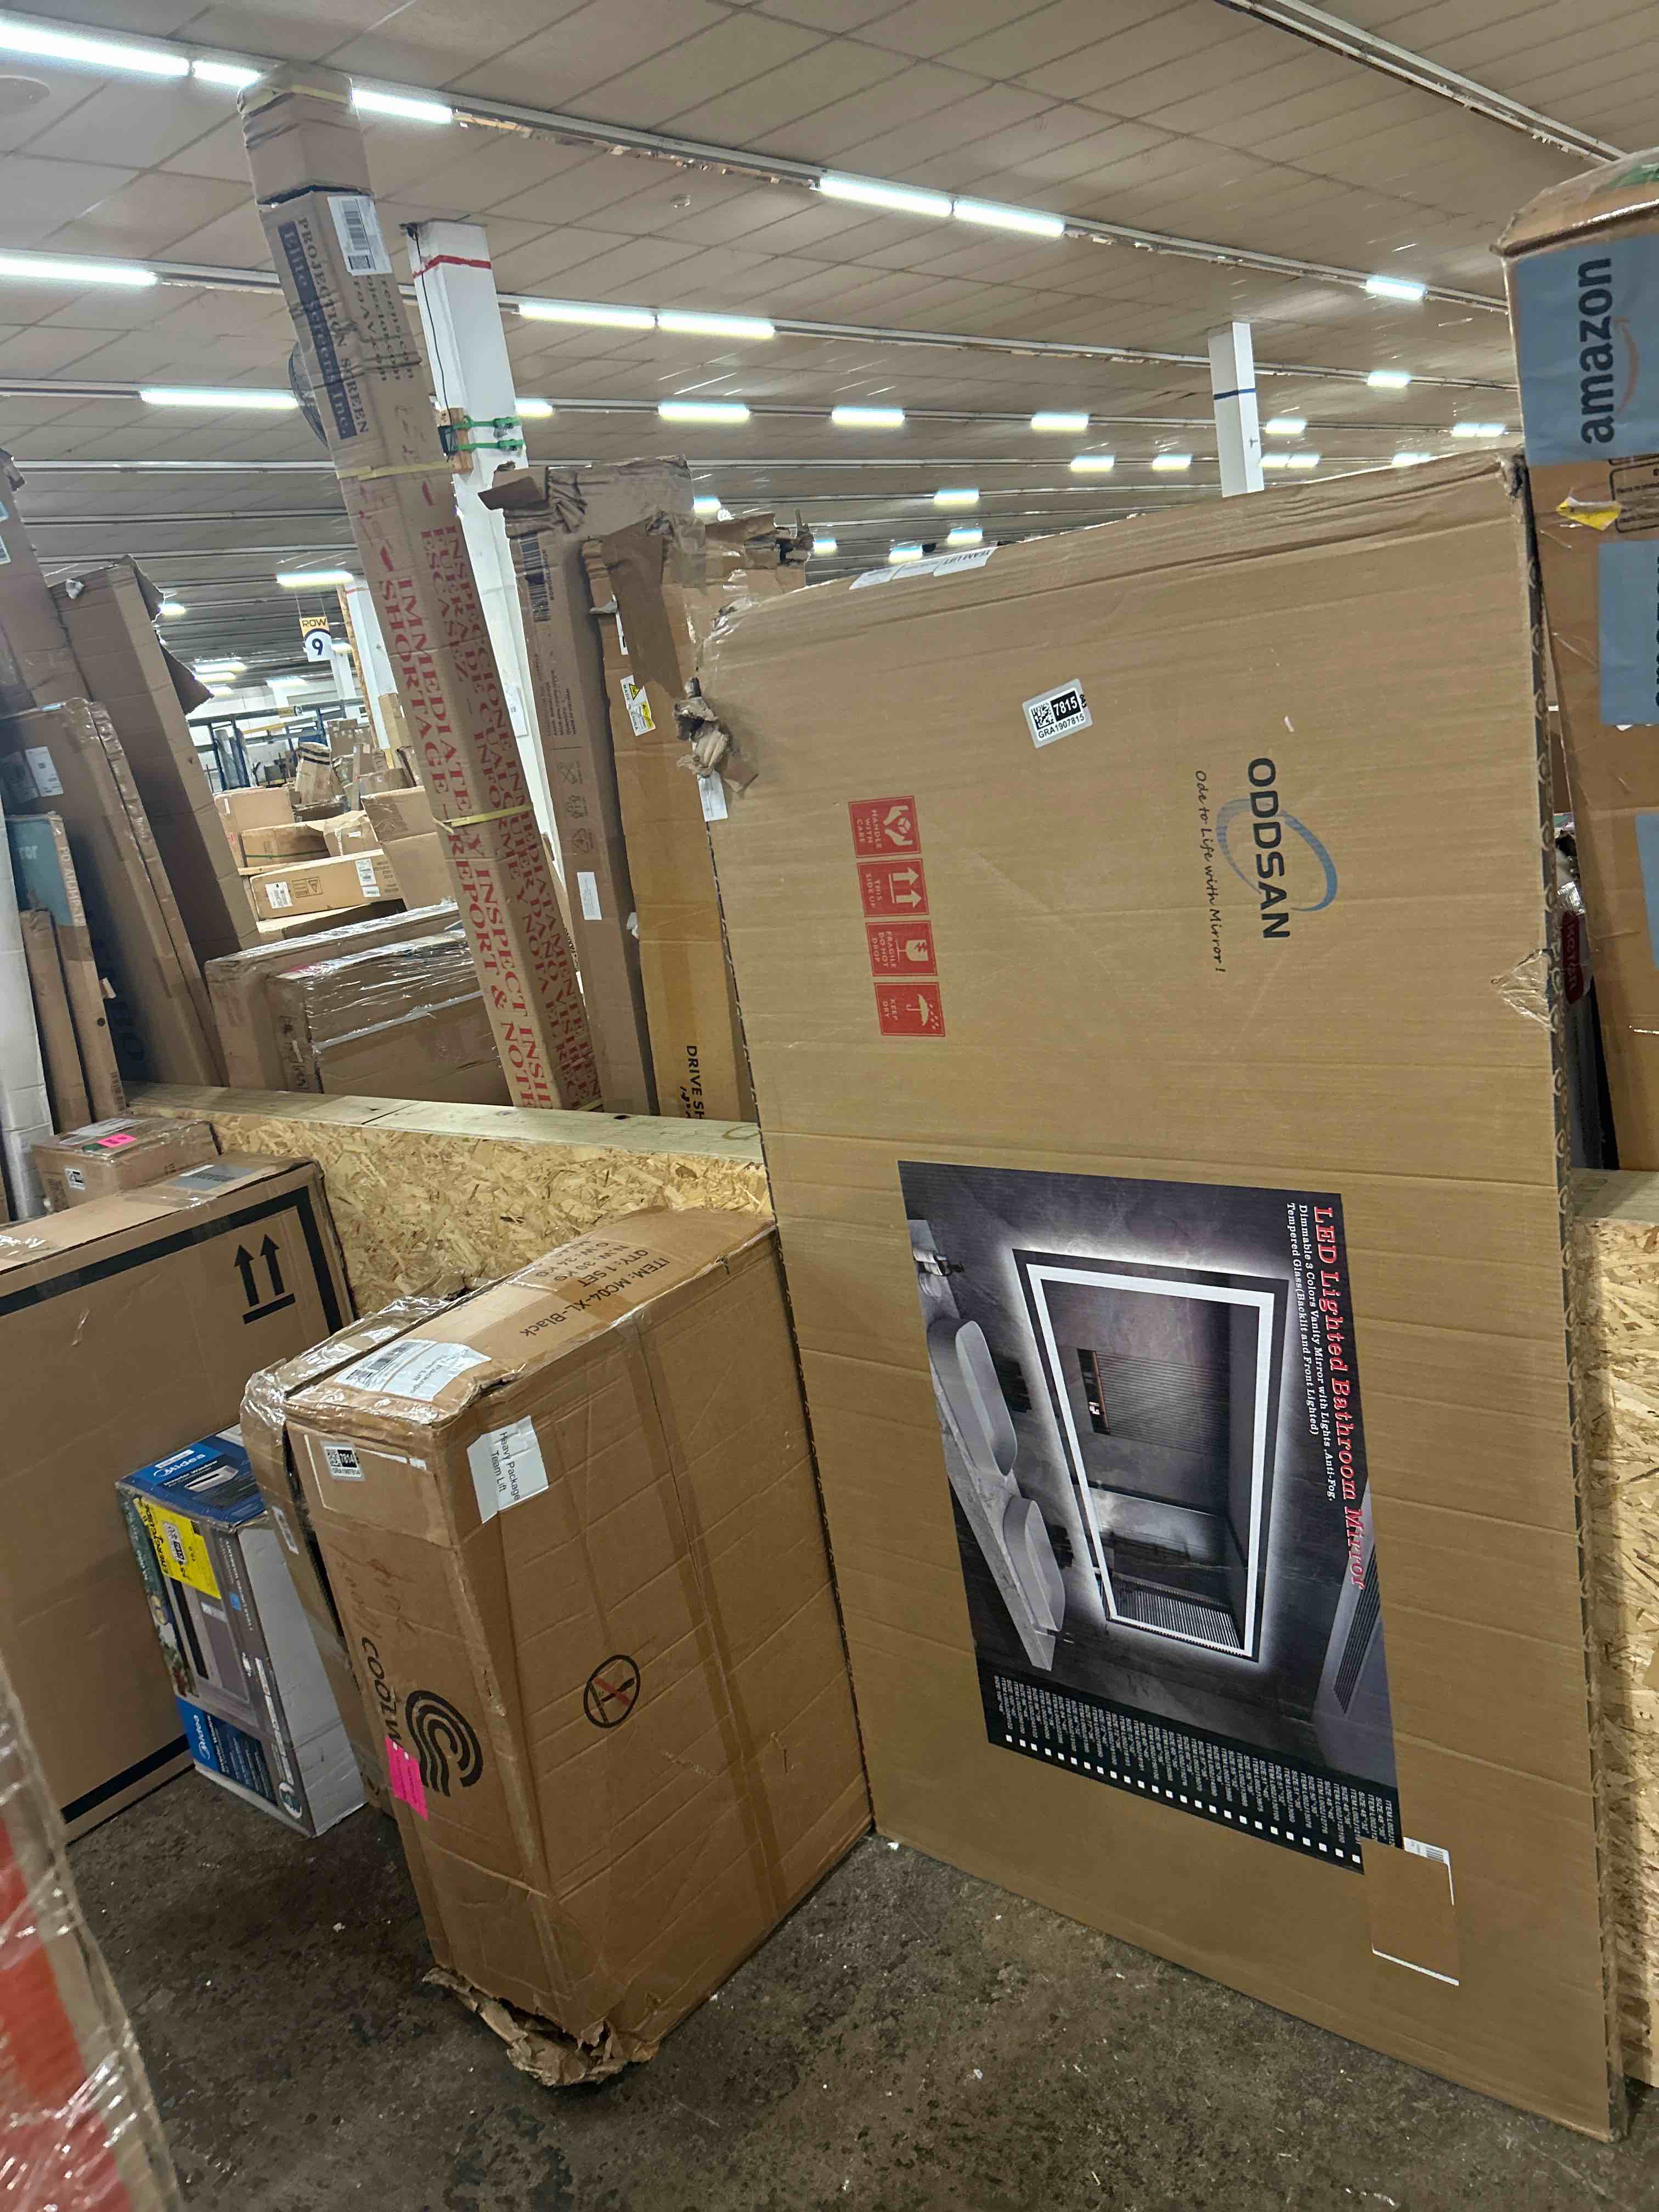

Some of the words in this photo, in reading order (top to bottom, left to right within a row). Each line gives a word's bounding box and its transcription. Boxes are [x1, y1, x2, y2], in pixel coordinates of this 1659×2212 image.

[1578, 257, 1614, 444] amazon
[302, 618, 326, 627] ROW
[311, 638, 323, 656] 9
[1053, 696, 1078, 716] 7815
[1037, 713, 1085, 738] GRA1907815
[375, 577, 450, 794] SHORTAGE
[445, 833, 500, 976] REPORT
[489, 984, 510, 1011] &
[1195, 770, 1206, 802] Ode
[870, 809, 882, 849] HANDLE
[1198, 805, 1207, 822] to
[856, 819, 865, 843] CARE
[864, 817, 873, 843] WITH
[1200, 827, 1212, 860] Life
[1248, 758, 1290, 939] ODDSAN
[865, 873, 873, 894] SIDE
[873, 879, 882, 901] THIS
[1204, 865, 1218, 909] with
[474, 868, 528, 1018] INSPECT
[871, 938, 880, 963] DROP
[878, 932, 885, 945] DO
[884, 930, 896, 969] FRAGILE
[880, 947, 888, 967] NOT
[882, 1001, 890, 1018] DRY
[889, 998, 898, 1021] KEEP
[686, 1045, 703, 1096] DRIVE
[1285, 1203, 1300, 1255] Tempered
[1299, 1204, 1312, 1260] Dimmable
[1313, 1206, 1336, 1264] LED
[614, 1246, 649, 1267] QTY:
[627, 1255, 670, 1282] ITEM:
[576, 1267, 606, 1289] SET
[1306, 1272, 1317, 1307] Colors
[518, 1275, 631, 1341] MC04-XL-Black
[1318, 1271, 1348, 1372] Lighted
[1310, 1310, 1320, 1344] Vanity
[1301, 1334, 1310, 1352] and
[1303, 1356, 1313, 1386] Front
[1313, 1347, 1324, 1383] Mirror
[1305, 1389, 1318, 1434] Lighted)
[1317, 1386, 1327, 1409] with
[1319, 1412, 1331, 1446] Lights
[1331, 1379, 1356, 1500] Bathroom
[500, 1431, 512, 1460] Heavy
[490, 1451, 503, 1476] Team
[496, 1477, 507, 1492] Lift
[505, 1461, 522, 1501] Package
[1345, 1506, 1364, 1590] Mirror
